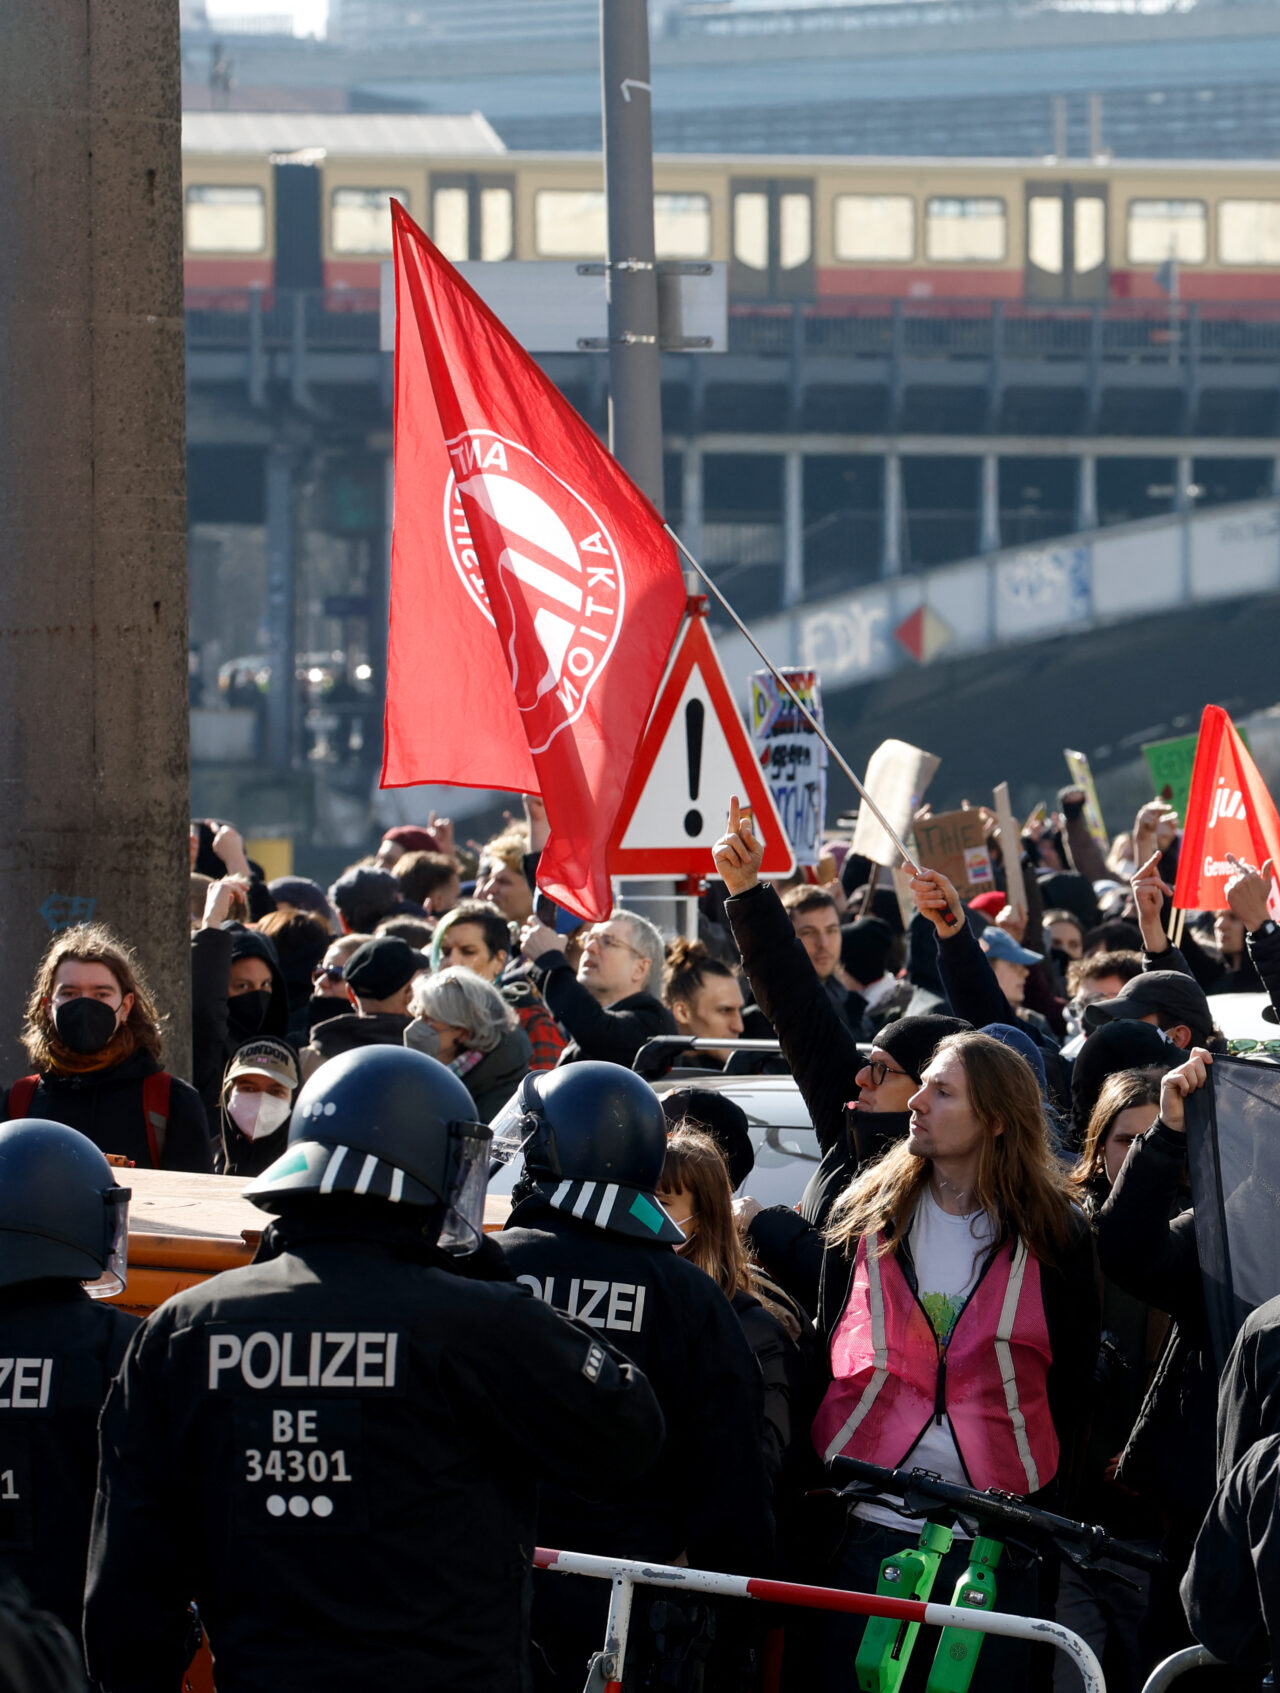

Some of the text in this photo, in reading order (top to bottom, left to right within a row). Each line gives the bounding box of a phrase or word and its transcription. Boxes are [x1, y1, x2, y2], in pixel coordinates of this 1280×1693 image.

[208, 1331, 399, 1390] POLIZEI
[272, 1409, 319, 1443] BE
[245, 1448, 352, 1482] 34301
